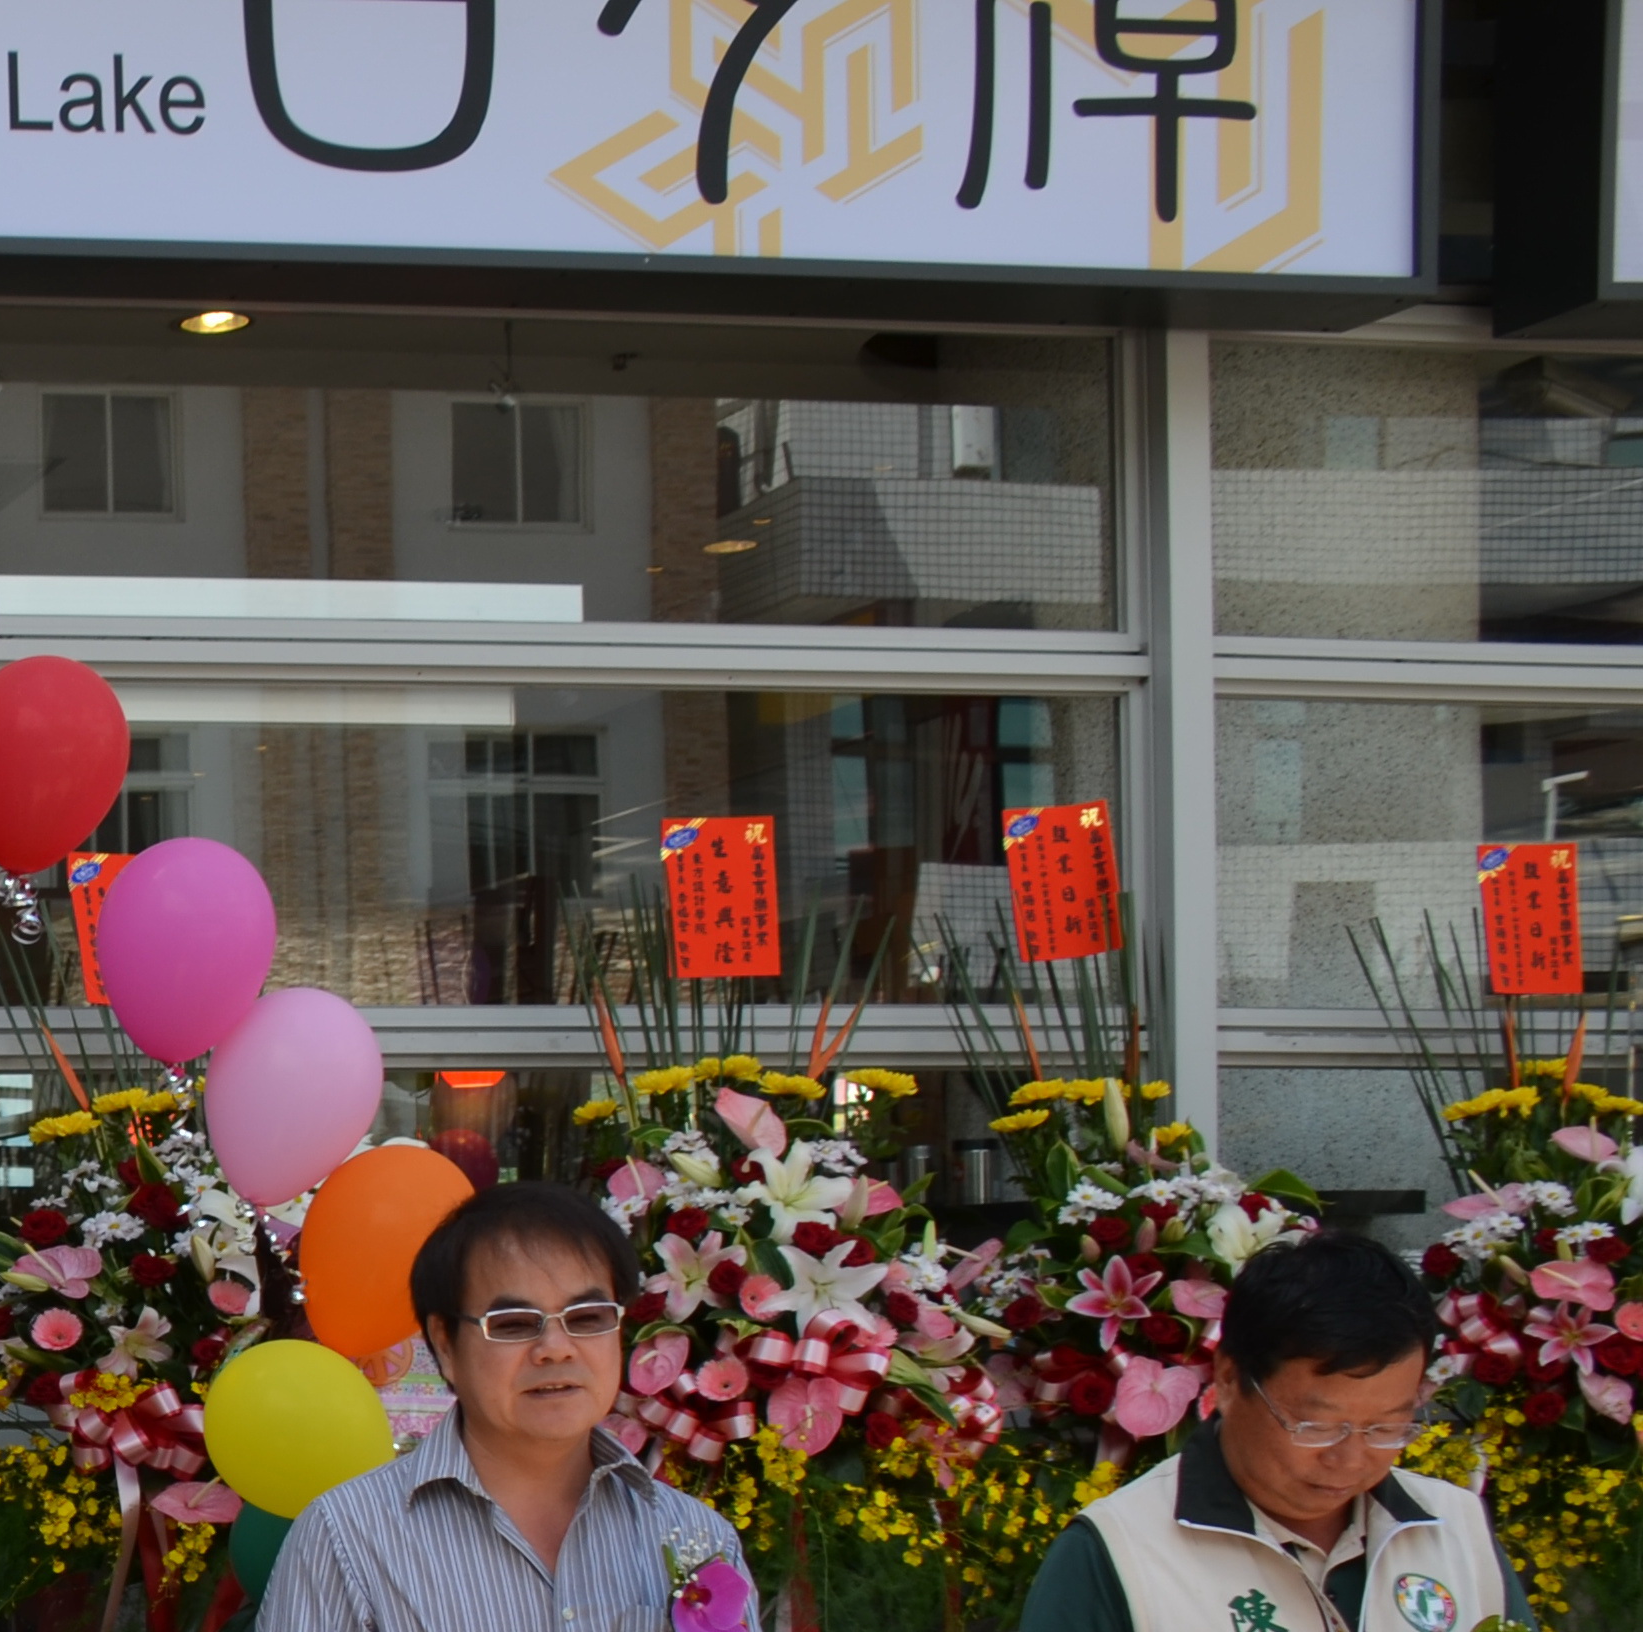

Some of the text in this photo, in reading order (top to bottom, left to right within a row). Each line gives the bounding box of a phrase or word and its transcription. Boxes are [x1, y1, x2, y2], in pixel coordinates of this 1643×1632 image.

[6, 51, 206, 135] Lake
[1079, 807, 1104, 828] 祝
[744, 822, 768, 844] 祝
